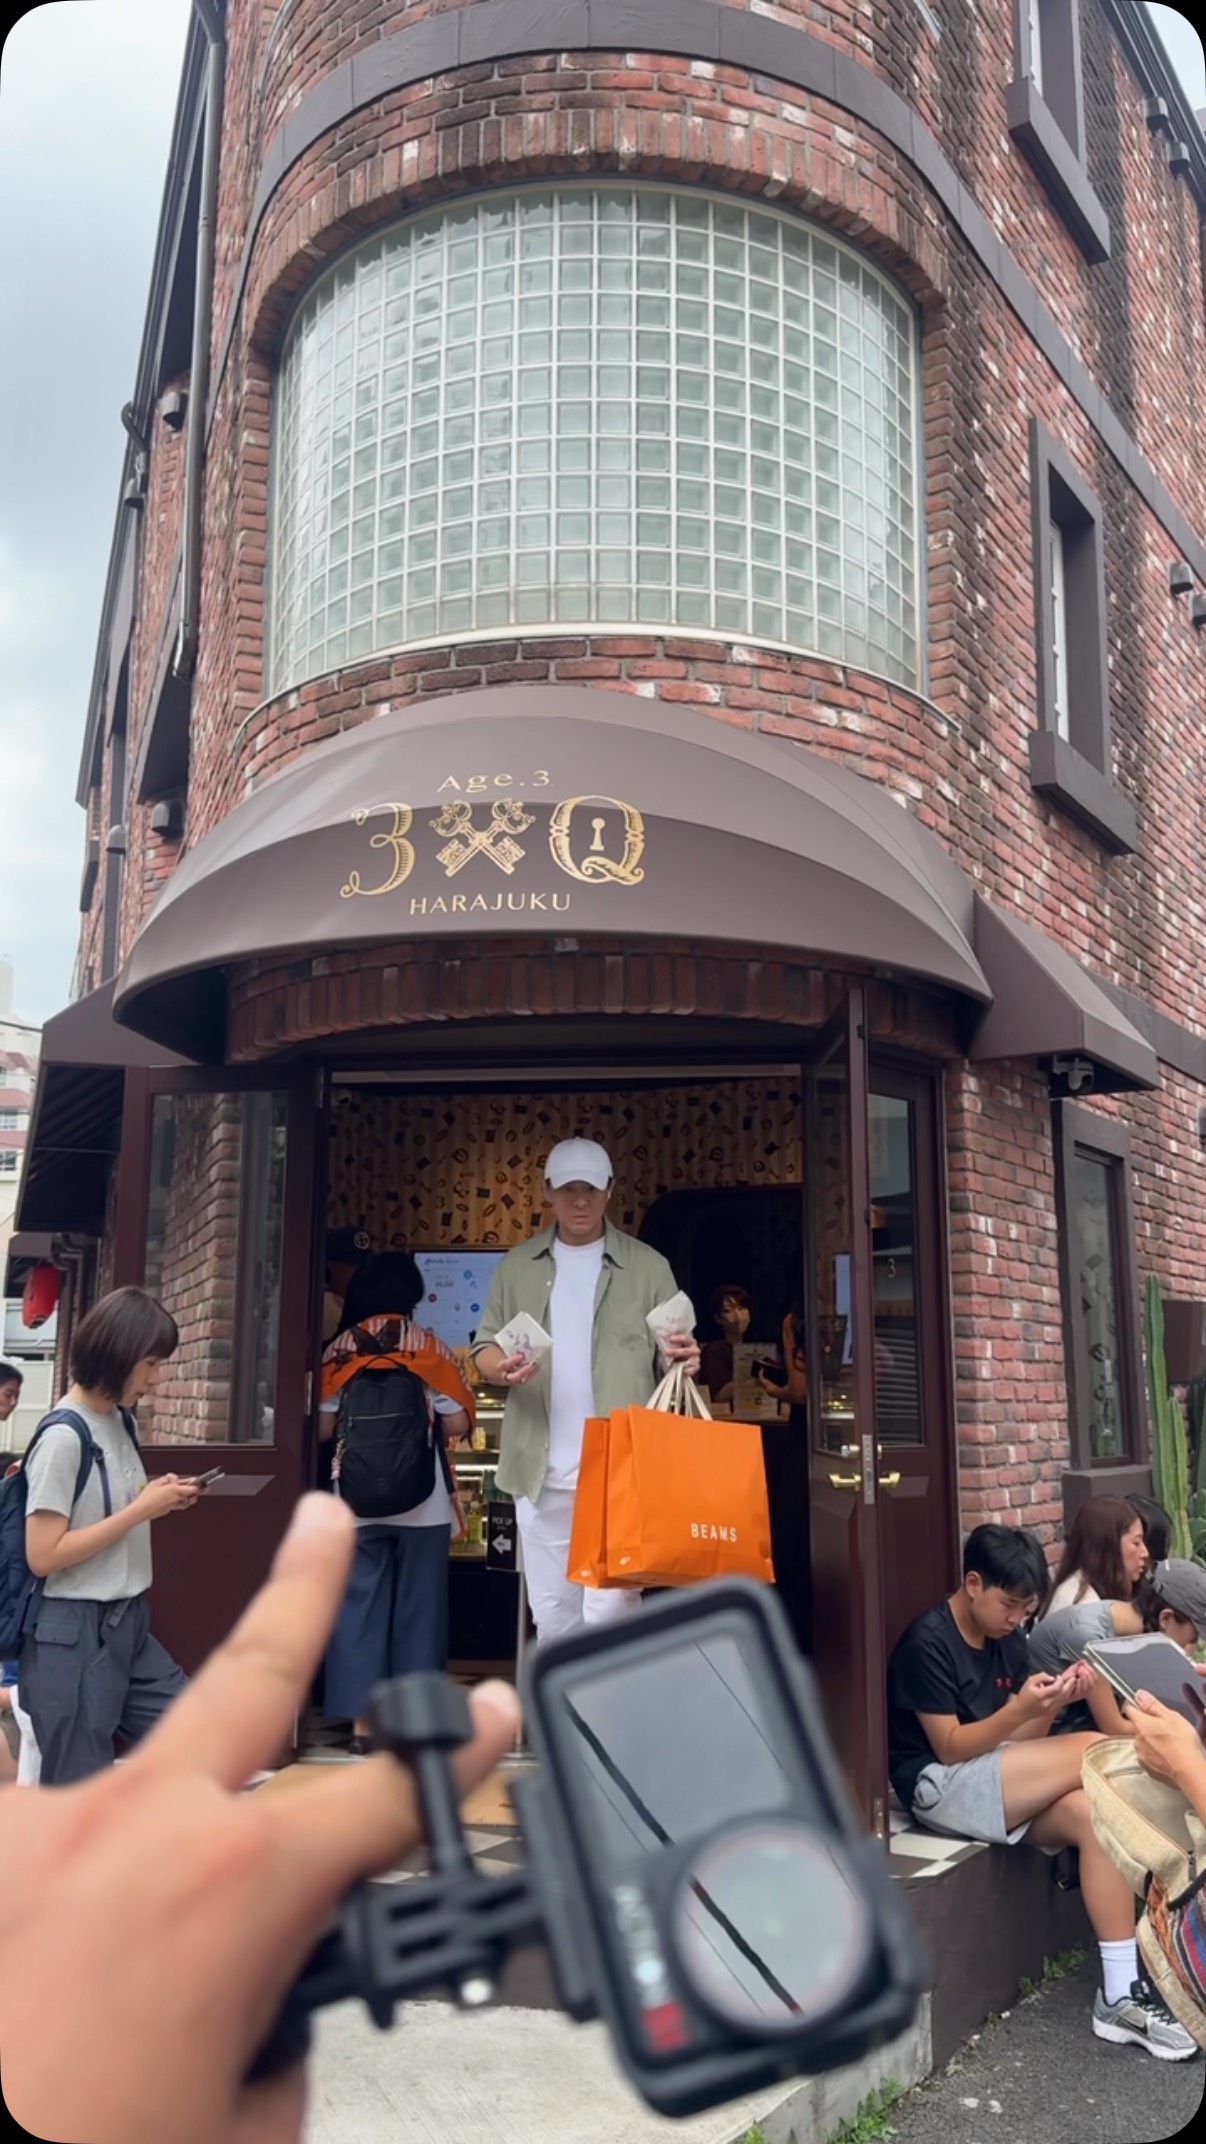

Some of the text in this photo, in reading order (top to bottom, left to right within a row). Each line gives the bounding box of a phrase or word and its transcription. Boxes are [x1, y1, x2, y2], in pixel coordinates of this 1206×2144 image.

[437, 769, 551, 793] Age.3
[340, 795, 645, 898] 3 Q
[410, 893, 571, 915] HARAJUKU
[691, 1523, 737, 1542] BEAMS
